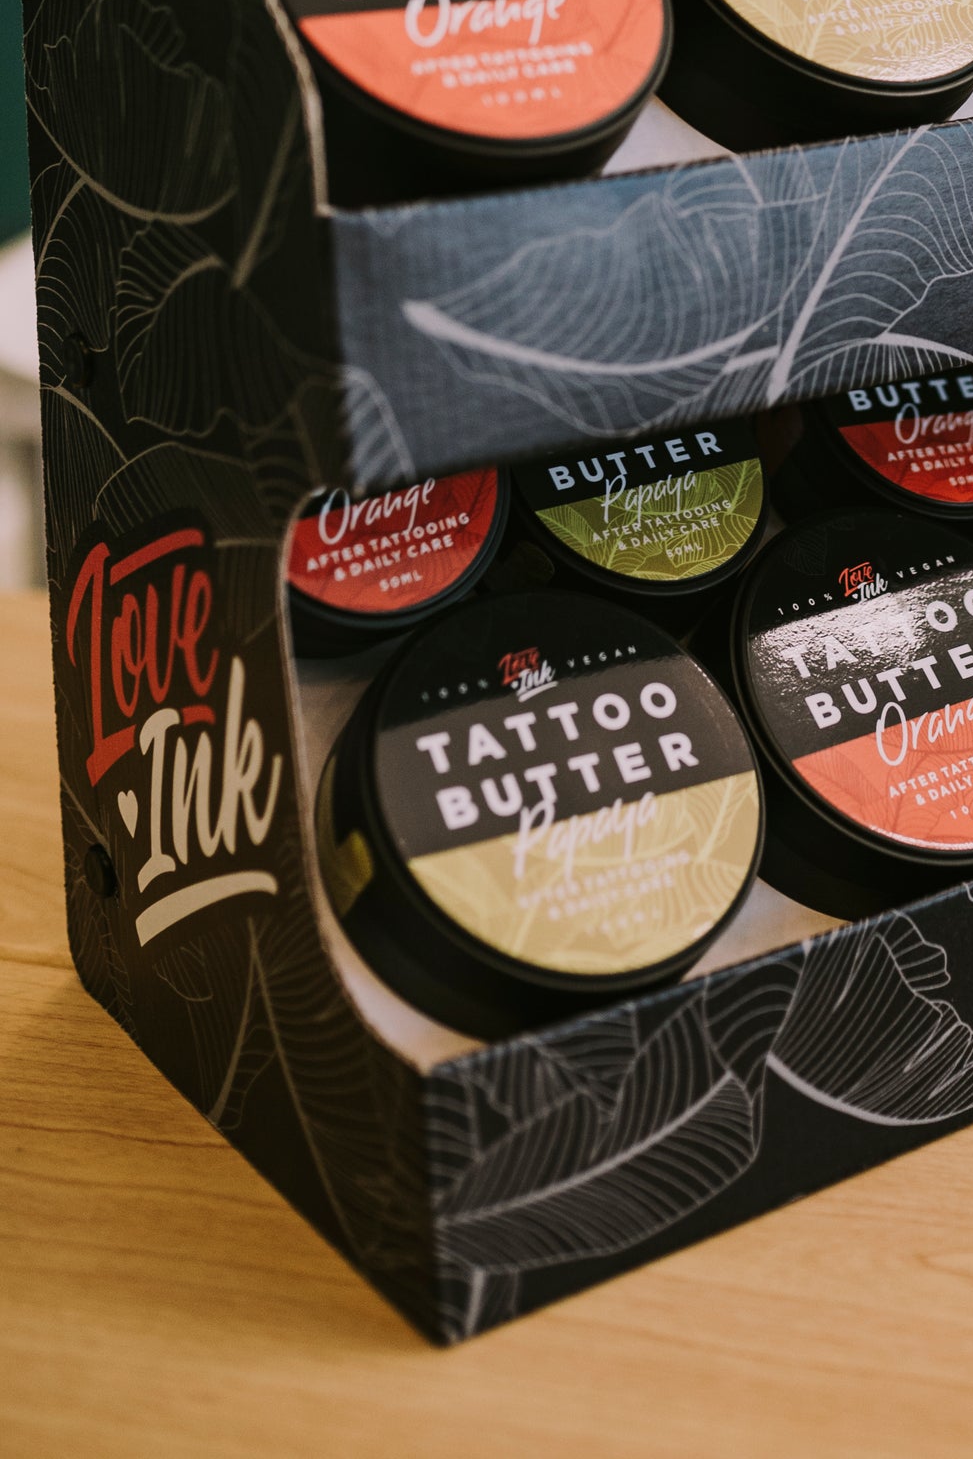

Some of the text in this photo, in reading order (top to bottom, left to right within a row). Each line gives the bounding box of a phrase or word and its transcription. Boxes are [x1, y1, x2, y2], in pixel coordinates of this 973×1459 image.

[808, 7, 860, 26] AFTER
[848, 17, 896, 35] DAILY
[547, 430, 724, 492] BUTTER
[887, 446, 936, 463] AFTER
[922, 455, 967, 472] DAILY
[317, 476, 437, 546] Orange
[600, 469, 698, 526] Papaya
[591, 498, 733, 544] AFTER TATTOOING
[616, 515, 722, 552] & DAILY CARE
[305, 511, 471, 573] AFTER TATTOOING
[332, 533, 455, 582] & DAILY CARE
[837, 561, 875, 598] Love
[895, 554, 956, 579] VEGAN
[777, 591, 833, 617] 100%
[856, 572, 888, 603] Ink
[67, 528, 219, 787] Love
[566, 644, 637, 669] VEGAN
[415, 681, 678, 774] TATTOO
[137, 655, 282, 893] Ink
[435, 731, 700, 831] BUTTER
[888, 770, 939, 799] AFTER
[914, 792, 926, 807] &
[927, 775, 973, 802] DAILY
[512, 790, 658, 881] Papaya
